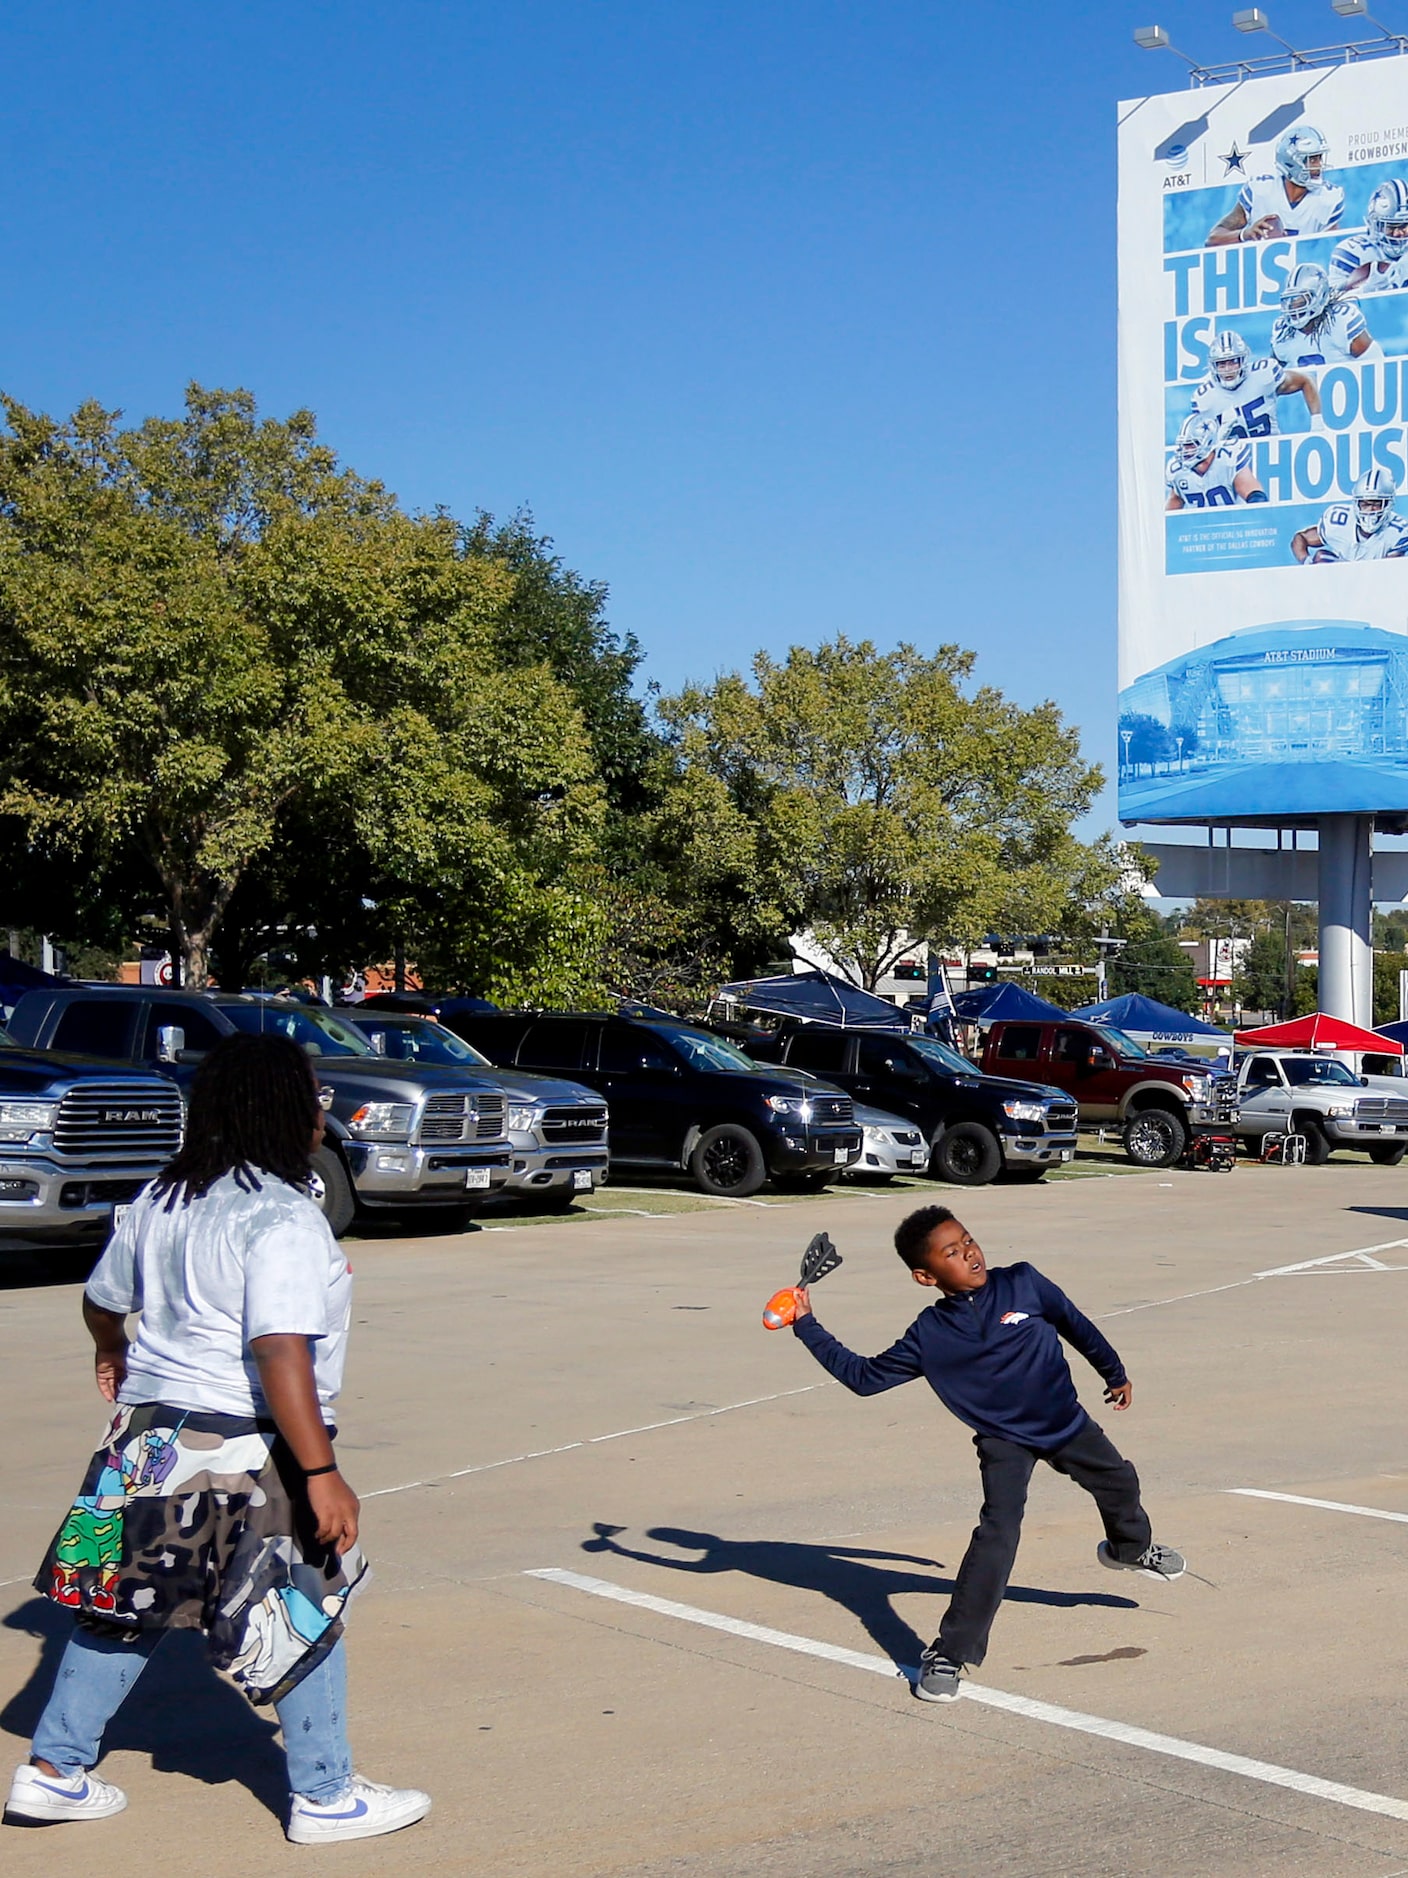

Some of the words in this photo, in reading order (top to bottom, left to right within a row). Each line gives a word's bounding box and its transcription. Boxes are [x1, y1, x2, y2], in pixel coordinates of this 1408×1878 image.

[1348, 131, 1379, 146] PROUD
[1163, 174, 1192, 189] AT&T
[1163, 242, 1293, 317] THIS
[1163, 316, 1212, 382] IS
[1263, 650, 1290, 663] AT&T
[1290, 647, 1336, 661] STADIUM
[1059, 967, 1073, 975] MILL
[1152, 1031, 1194, 1042] COWBOYS
[105, 1110, 158, 1121] RAM
[567, 1120, 597, 1128] RAM
